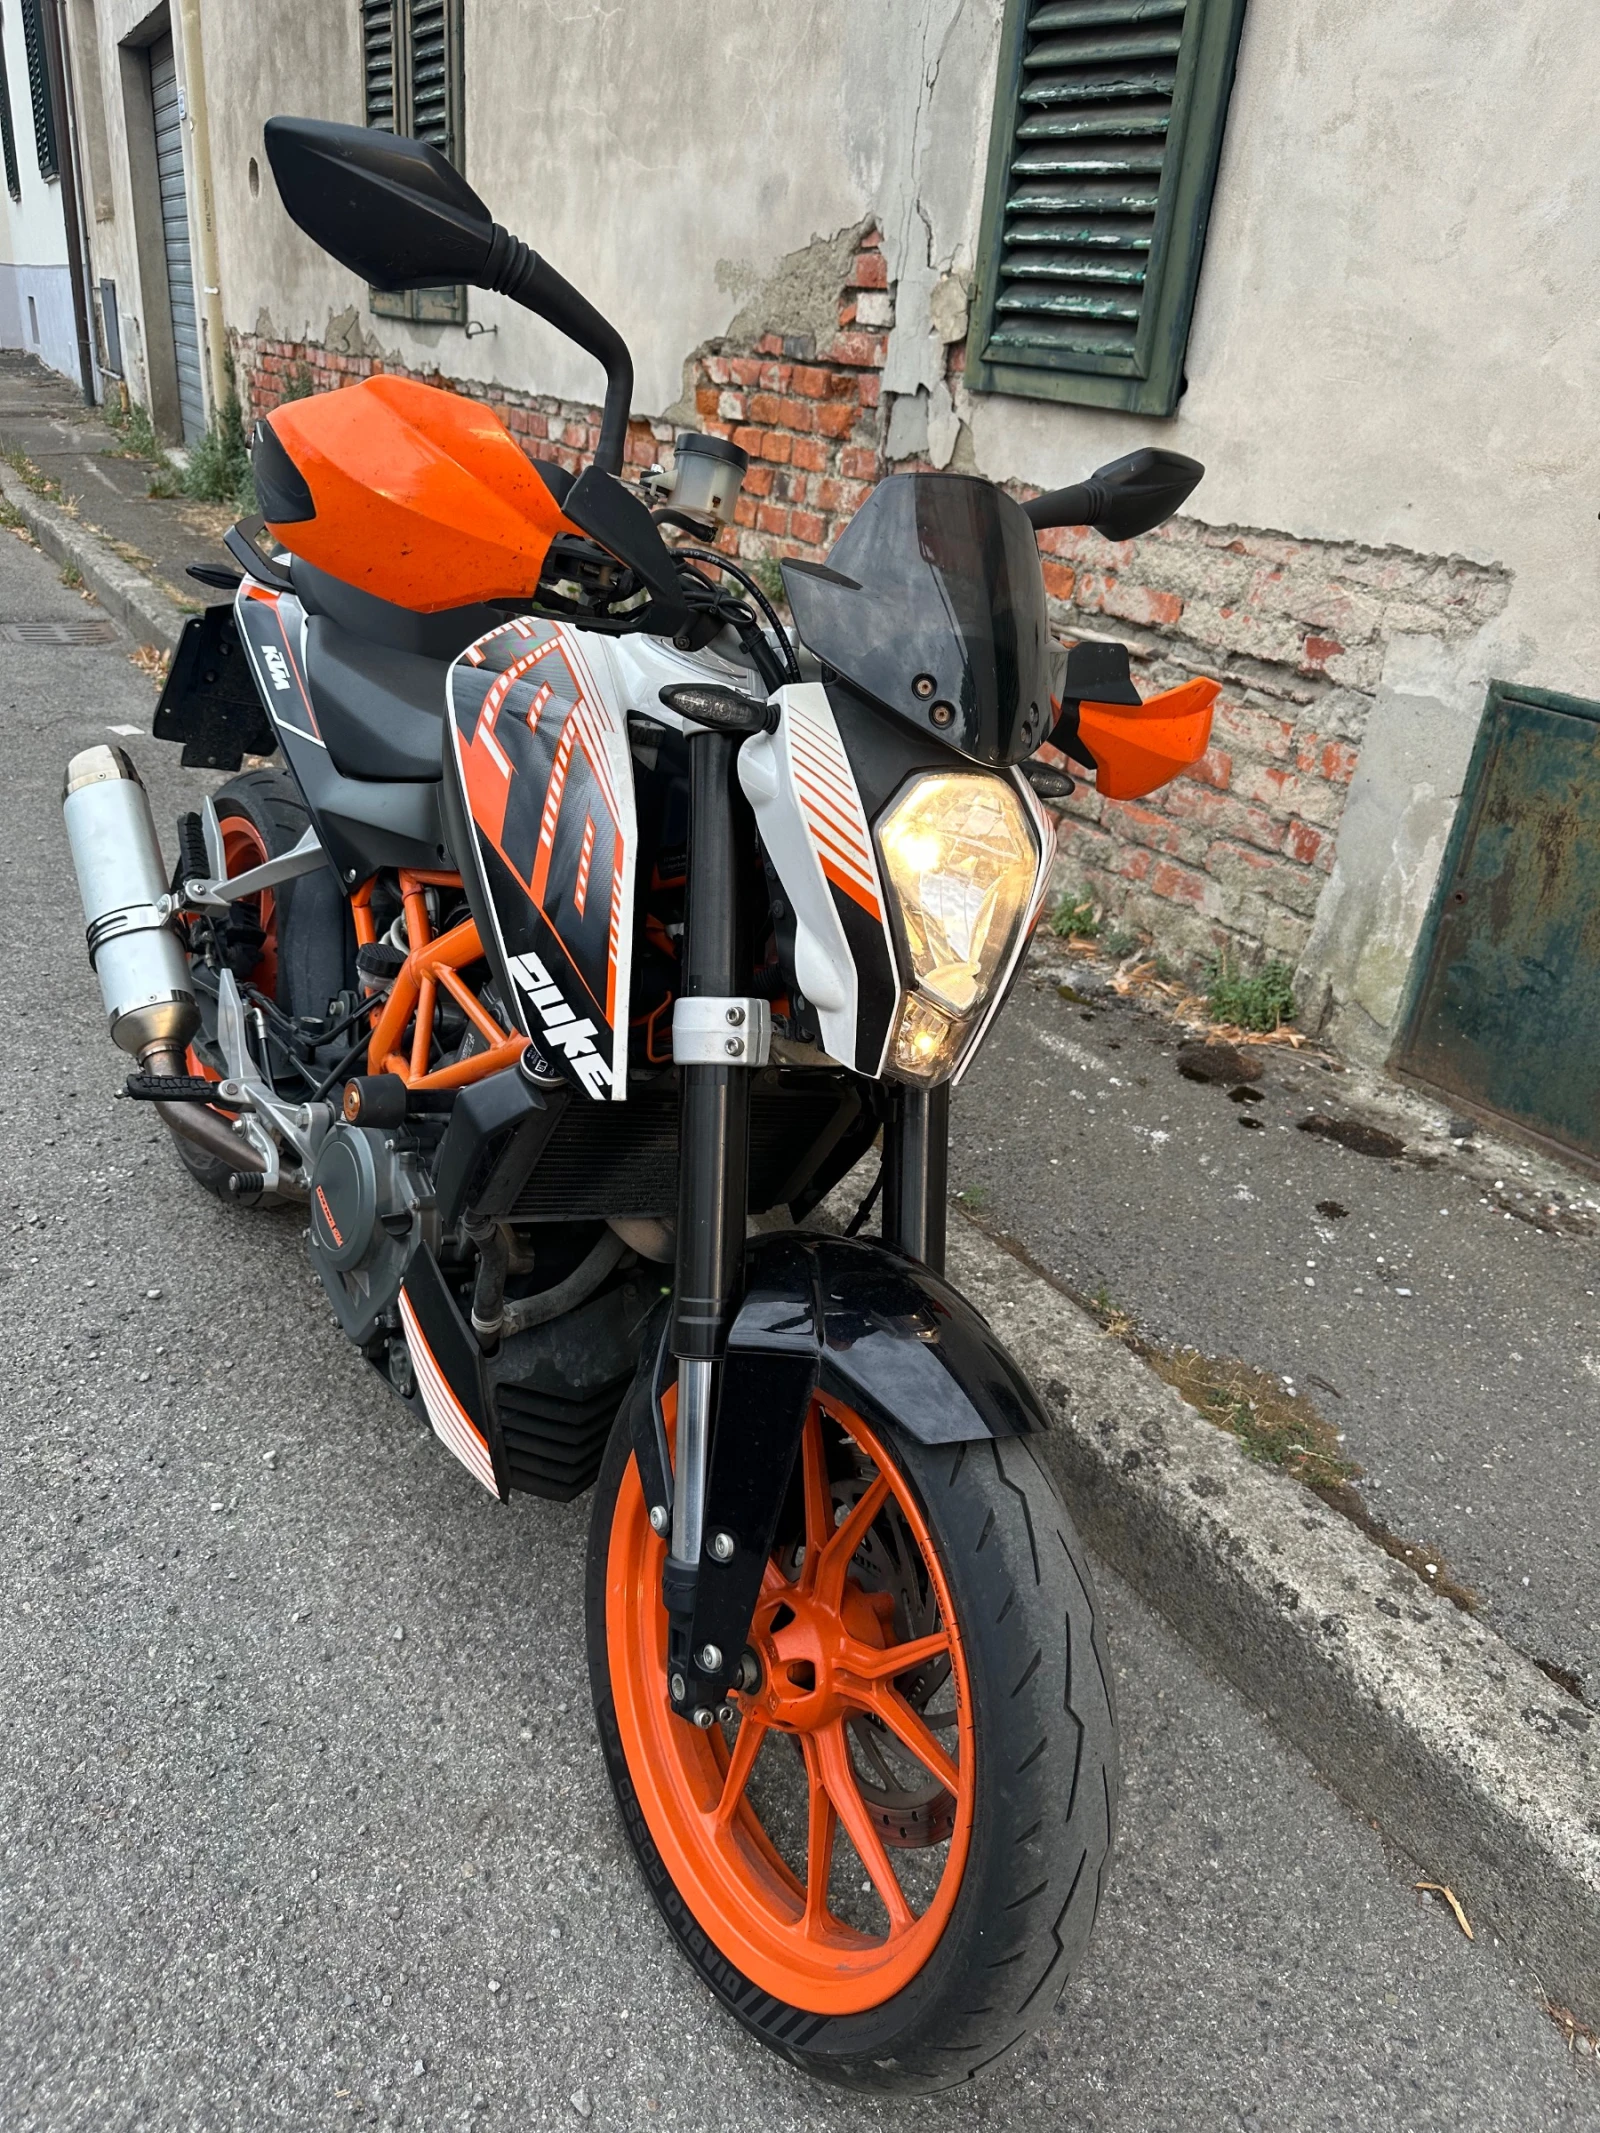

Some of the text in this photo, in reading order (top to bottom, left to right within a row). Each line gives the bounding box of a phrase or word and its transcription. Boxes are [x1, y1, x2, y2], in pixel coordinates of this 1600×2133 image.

[261, 645, 291, 691] KTM
[507, 952, 613, 1100] DUKE
[920, 1541, 947, 1620] CHANGE
[951, 1653, 963, 1709] GOOD
[616, 1777, 667, 1887] ROSSO
[666, 1891, 742, 1999] DIABLO
